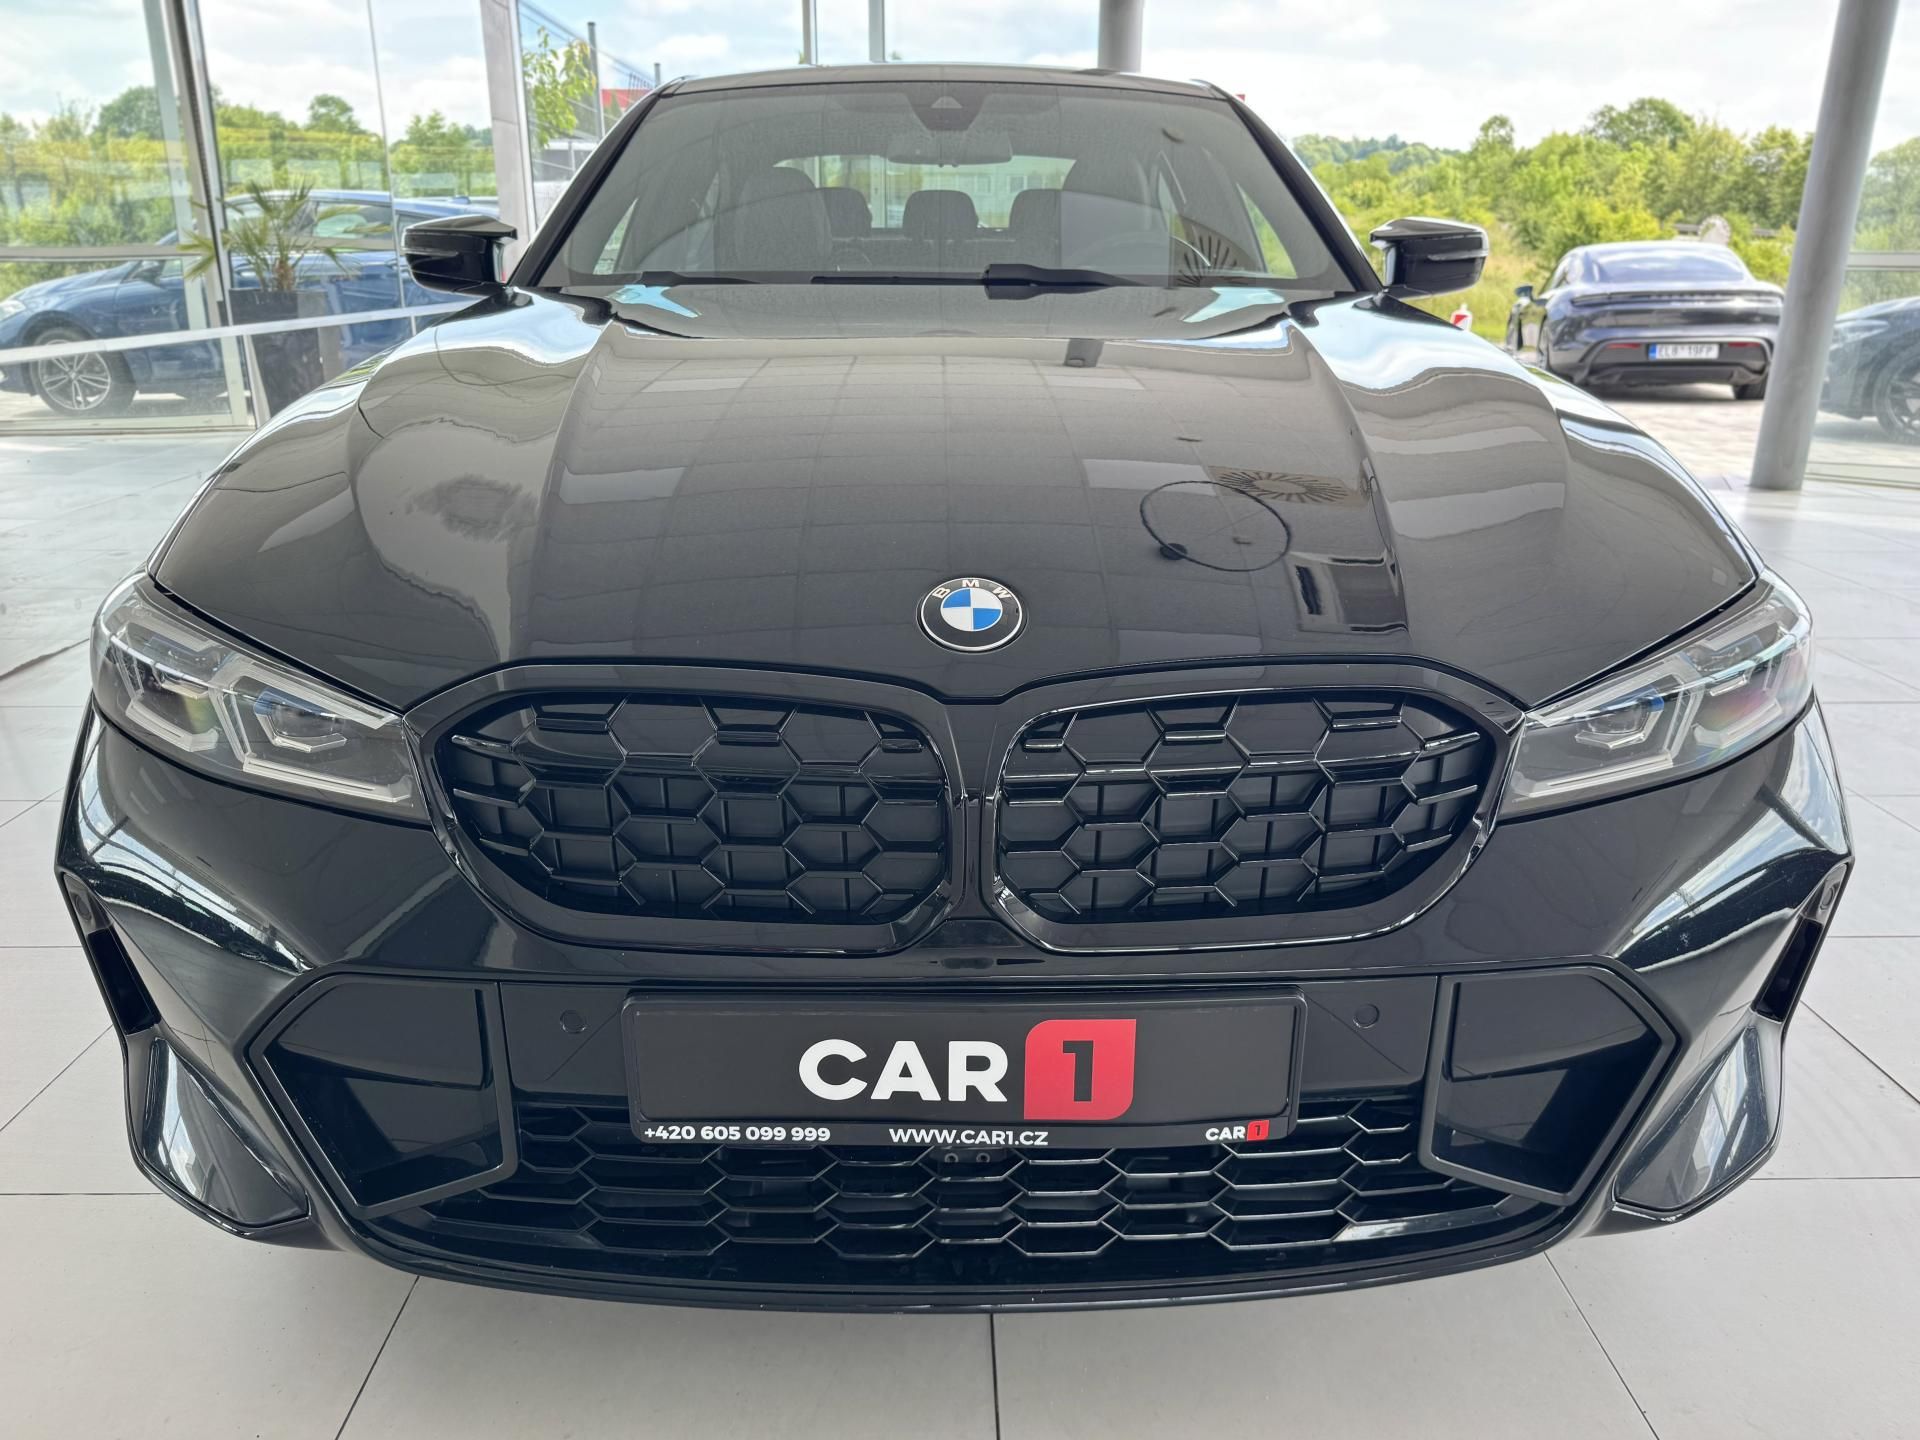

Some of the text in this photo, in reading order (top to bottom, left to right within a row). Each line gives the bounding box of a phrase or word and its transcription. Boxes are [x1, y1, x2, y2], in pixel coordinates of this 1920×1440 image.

[932, 579, 1012, 599] BMW
[798, 1038, 1094, 1102] CAR 1
[644, 1125, 831, 1142] +420 605 099 999
[888, 1127, 1049, 1146] WWW.CAR1.CZ
[1205, 1125, 1246, 1141] CAR
